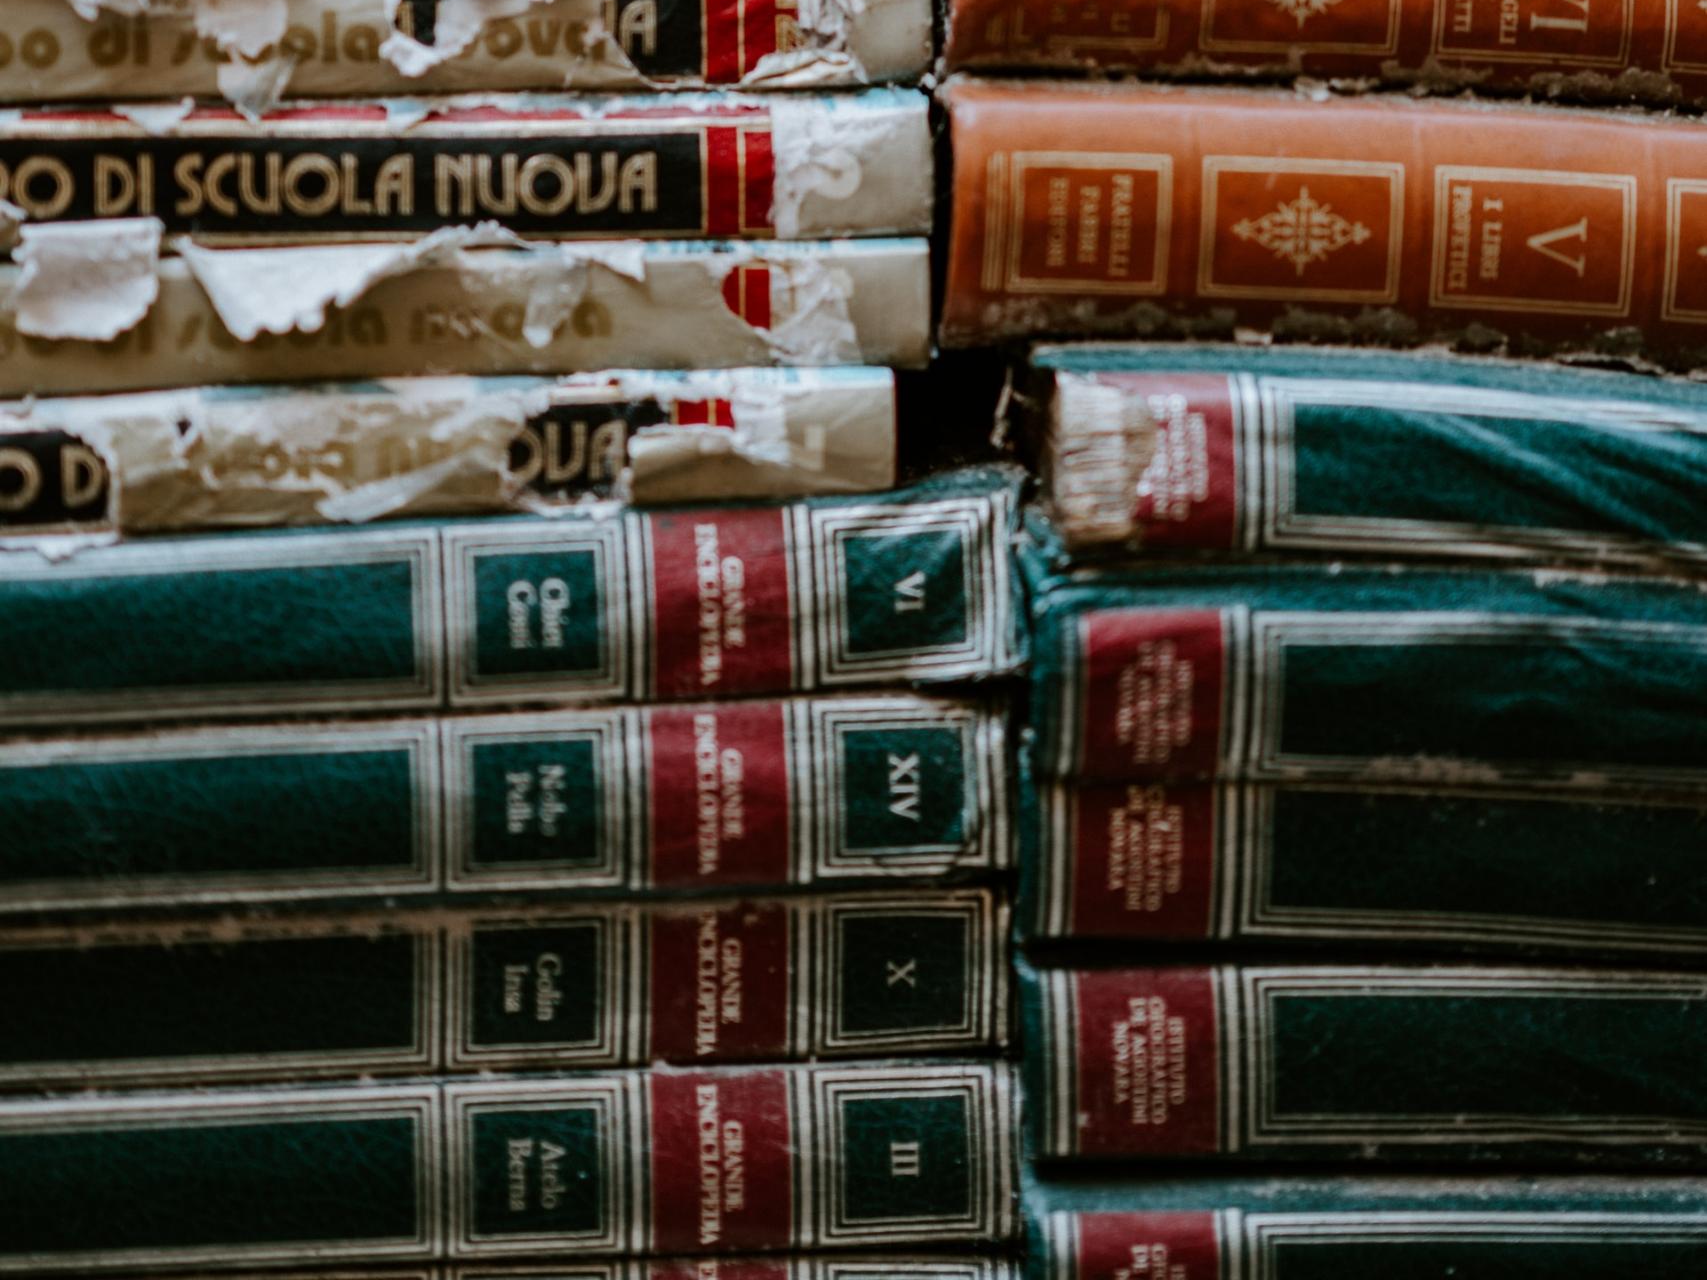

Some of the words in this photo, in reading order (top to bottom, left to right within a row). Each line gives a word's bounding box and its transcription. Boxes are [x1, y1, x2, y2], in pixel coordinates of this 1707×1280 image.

[93, 151, 156, 217] DI
[173, 151, 414, 218] SCUOLA
[434, 150, 657, 217] NUOVA
[1526, 216, 1588, 278] V
[893, 570, 927, 614] VI
[887, 751, 921, 823] XIV
[720, 937, 742, 1024] GRANDE
[886, 958, 917, 989] X
[1113, 1021, 1131, 1104] NOVARA
[695, 1083, 721, 1245] ENCICLOPEDIA
[721, 1119, 745, 1213] GRANDE
[889, 1141, 921, 1178] III
